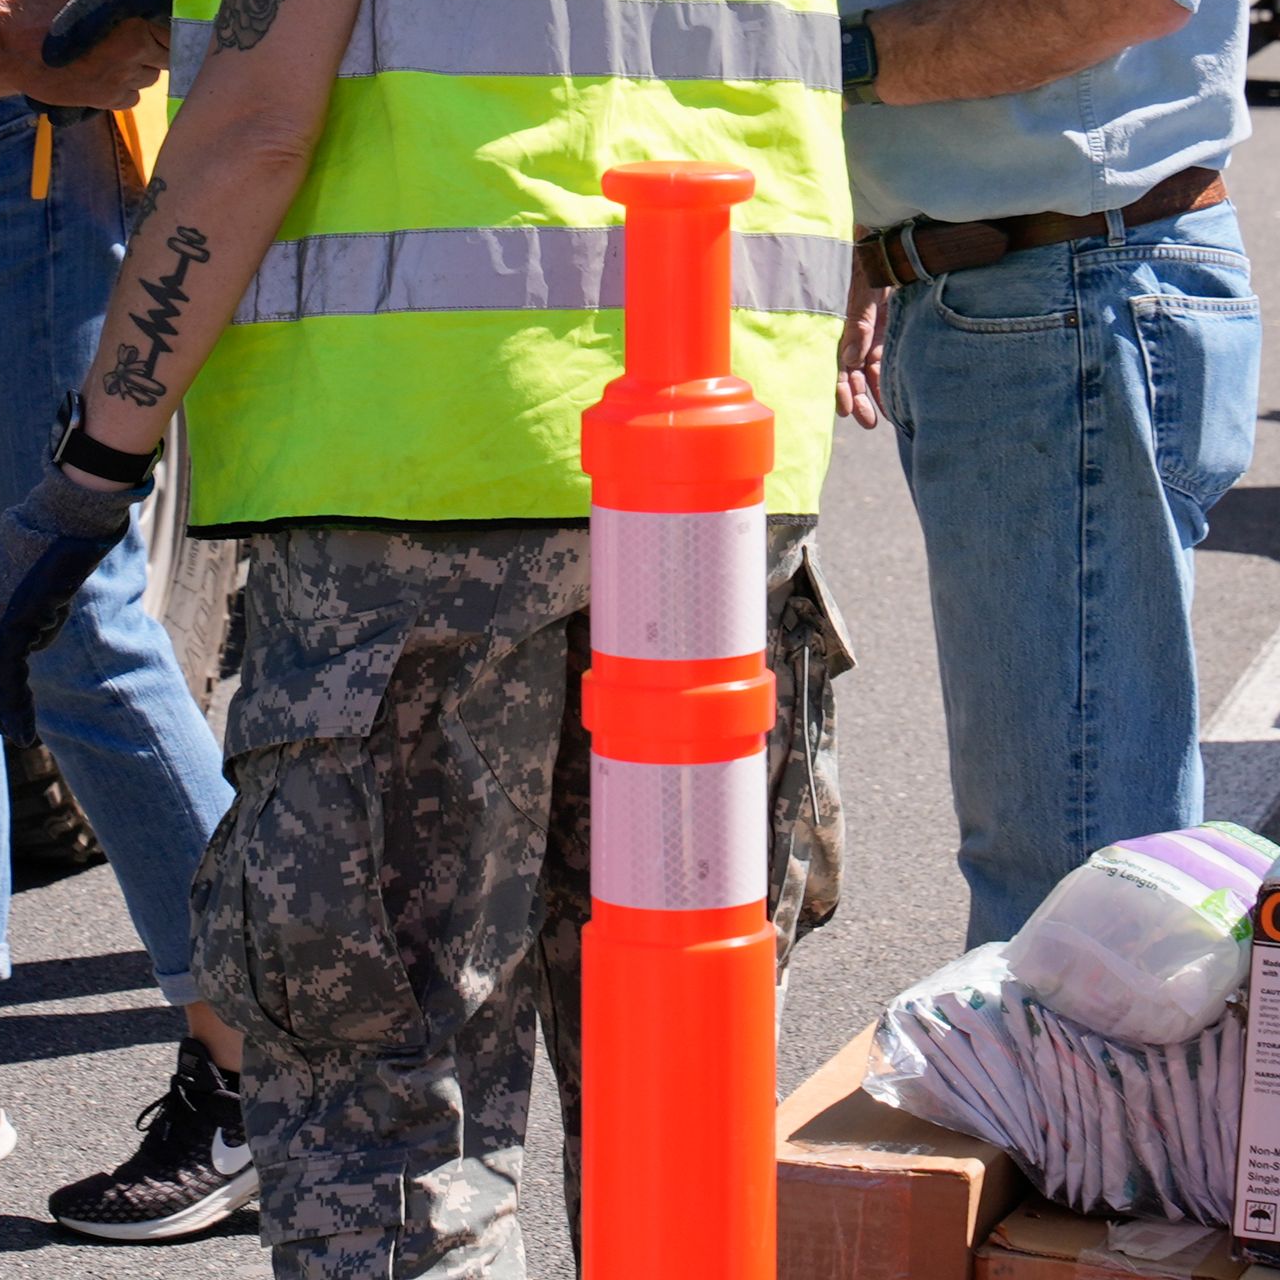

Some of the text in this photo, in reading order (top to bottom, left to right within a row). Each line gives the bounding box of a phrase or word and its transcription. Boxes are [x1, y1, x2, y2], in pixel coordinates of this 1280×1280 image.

[1091, 861, 1158, 891] Long Length
[1255, 1070, 1280, 1080] HARSH
[1248, 1172, 1280, 1186] Single
